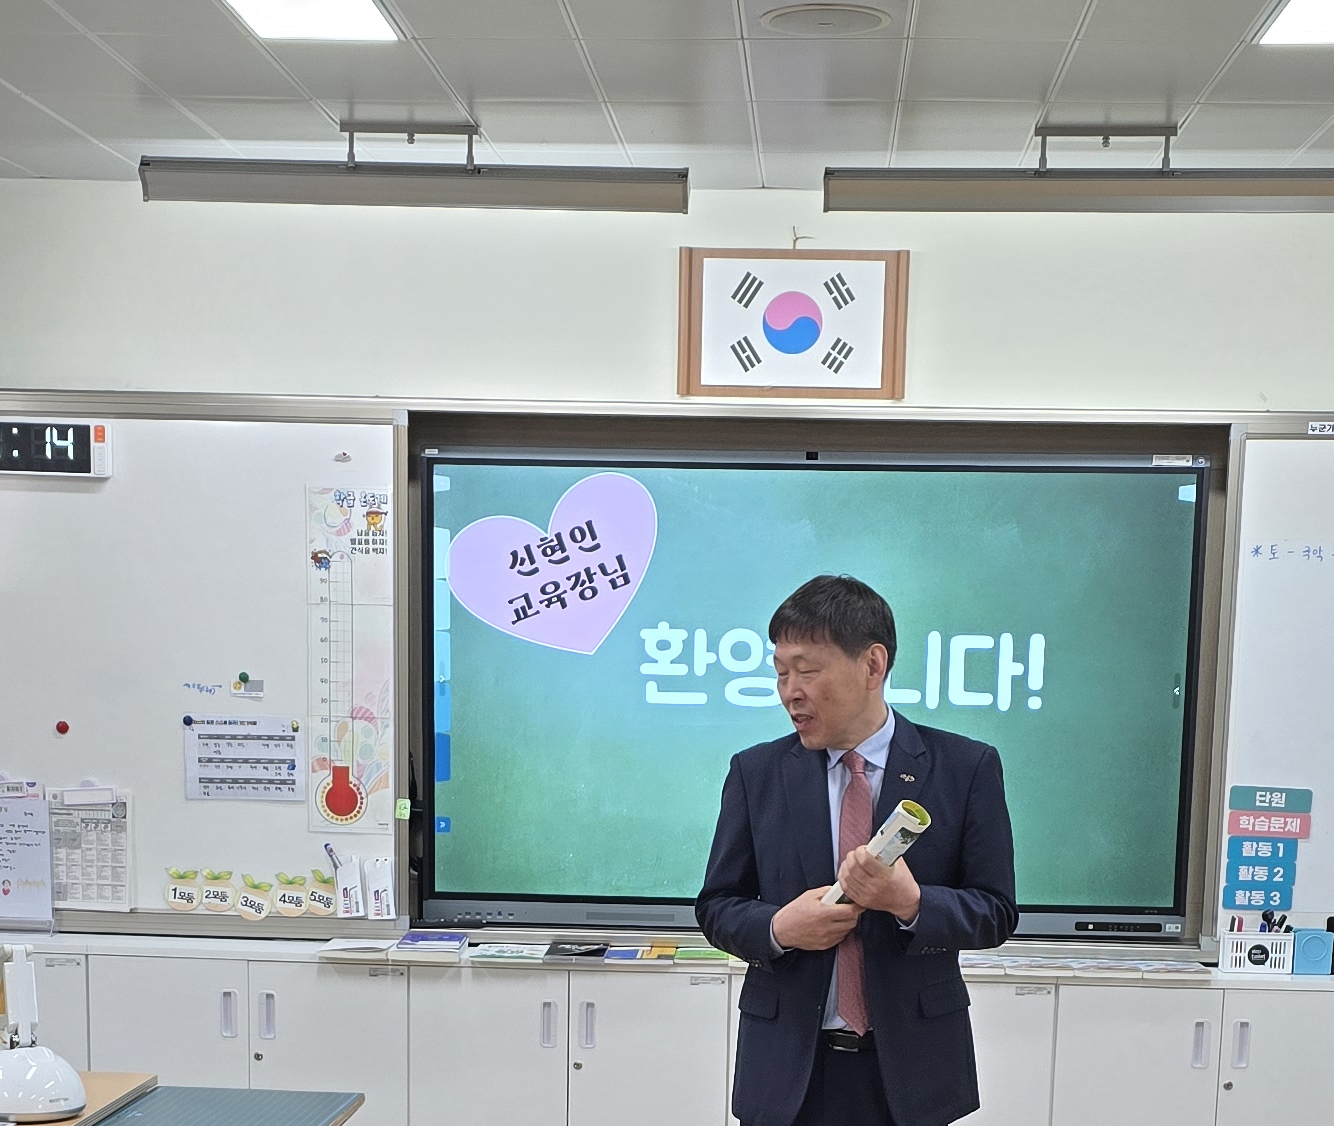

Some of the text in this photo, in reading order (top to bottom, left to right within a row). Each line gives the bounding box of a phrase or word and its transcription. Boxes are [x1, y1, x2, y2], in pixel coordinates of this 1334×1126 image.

[1310, 423, 1334, 433] 누군가
[334, 490, 355, 508] 학급
[508, 519, 602, 578] 신현인
[1269, 544, 1280, 560] 토
[507, 553, 632, 627] 교육장님
[639, 621, 1046, 712] 환영니다!
[1255, 790, 1286, 808] 단원
[1239, 815, 1301, 834] 학습문제
[1242, 841, 1284, 857] 활동 1
[1238, 865, 1284, 882] 활동 2
[171, 887, 196, 904] 1모둠
[204, 889, 229, 903] 2모둠
[240, 895, 265, 915] 3모둠
[278, 892, 304, 908] 4모둠
[309, 890, 333, 909] 5모둠
[1235, 890, 1281, 906] 활동 3
